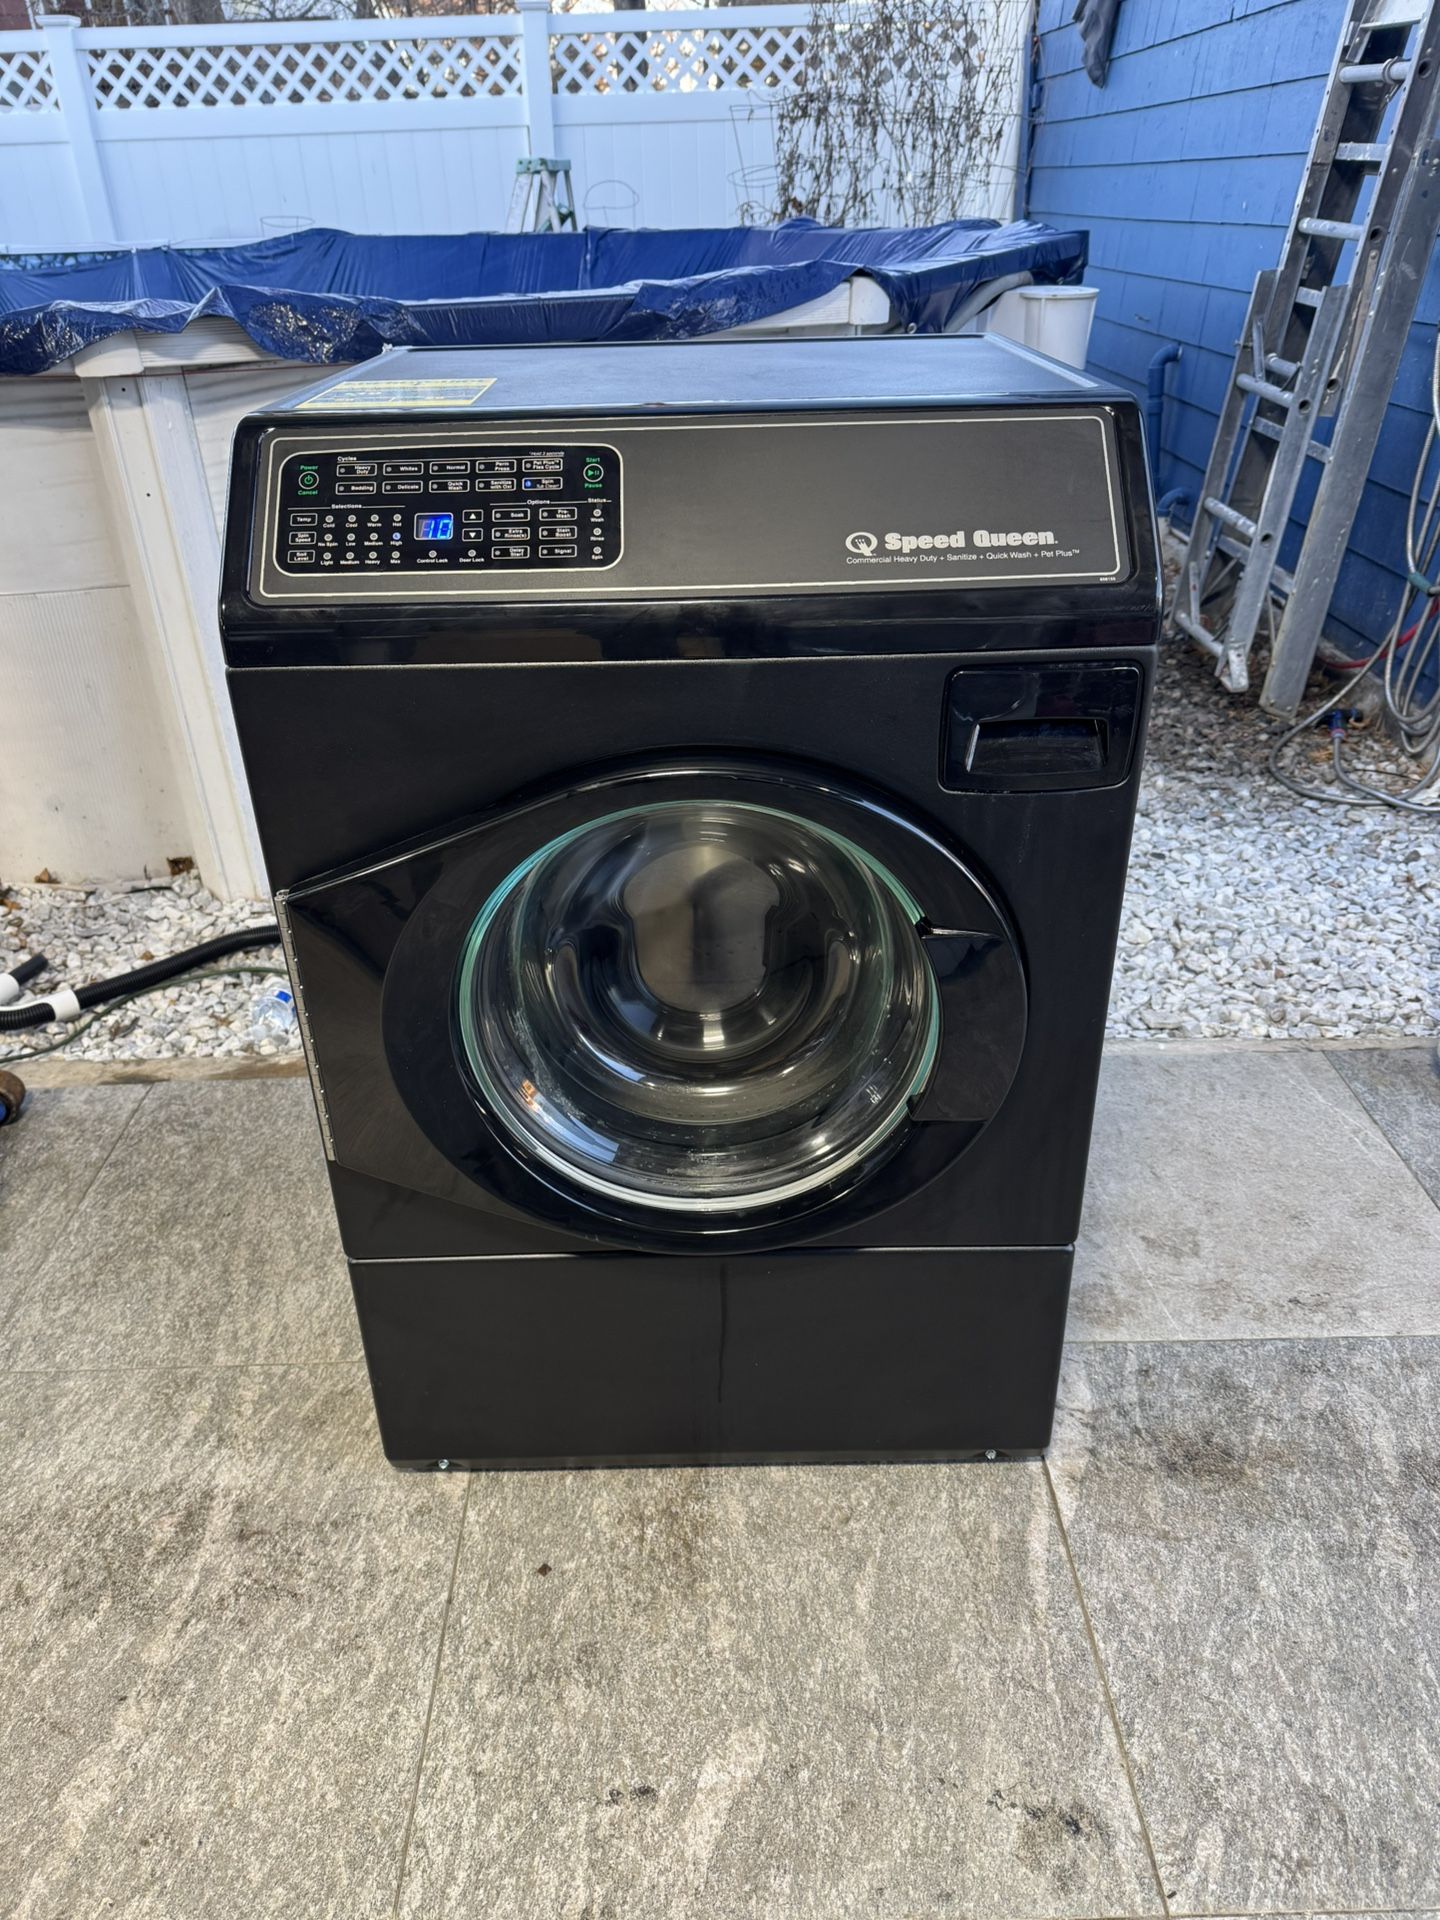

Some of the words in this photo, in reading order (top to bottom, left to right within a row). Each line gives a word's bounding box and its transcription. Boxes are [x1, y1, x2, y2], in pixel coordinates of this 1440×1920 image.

[884, 531, 966, 553] Speed
[846, 555, 891, 564] Commercial
[894, 554, 918, 564] Heavy
[920, 554, 938, 562] Duty
[947, 552, 977, 561] Sanitize
[987, 551, 1008, 560] Quick
[1010, 550, 1032, 559] Wash
[1041, 549, 1054, 557] Pet
